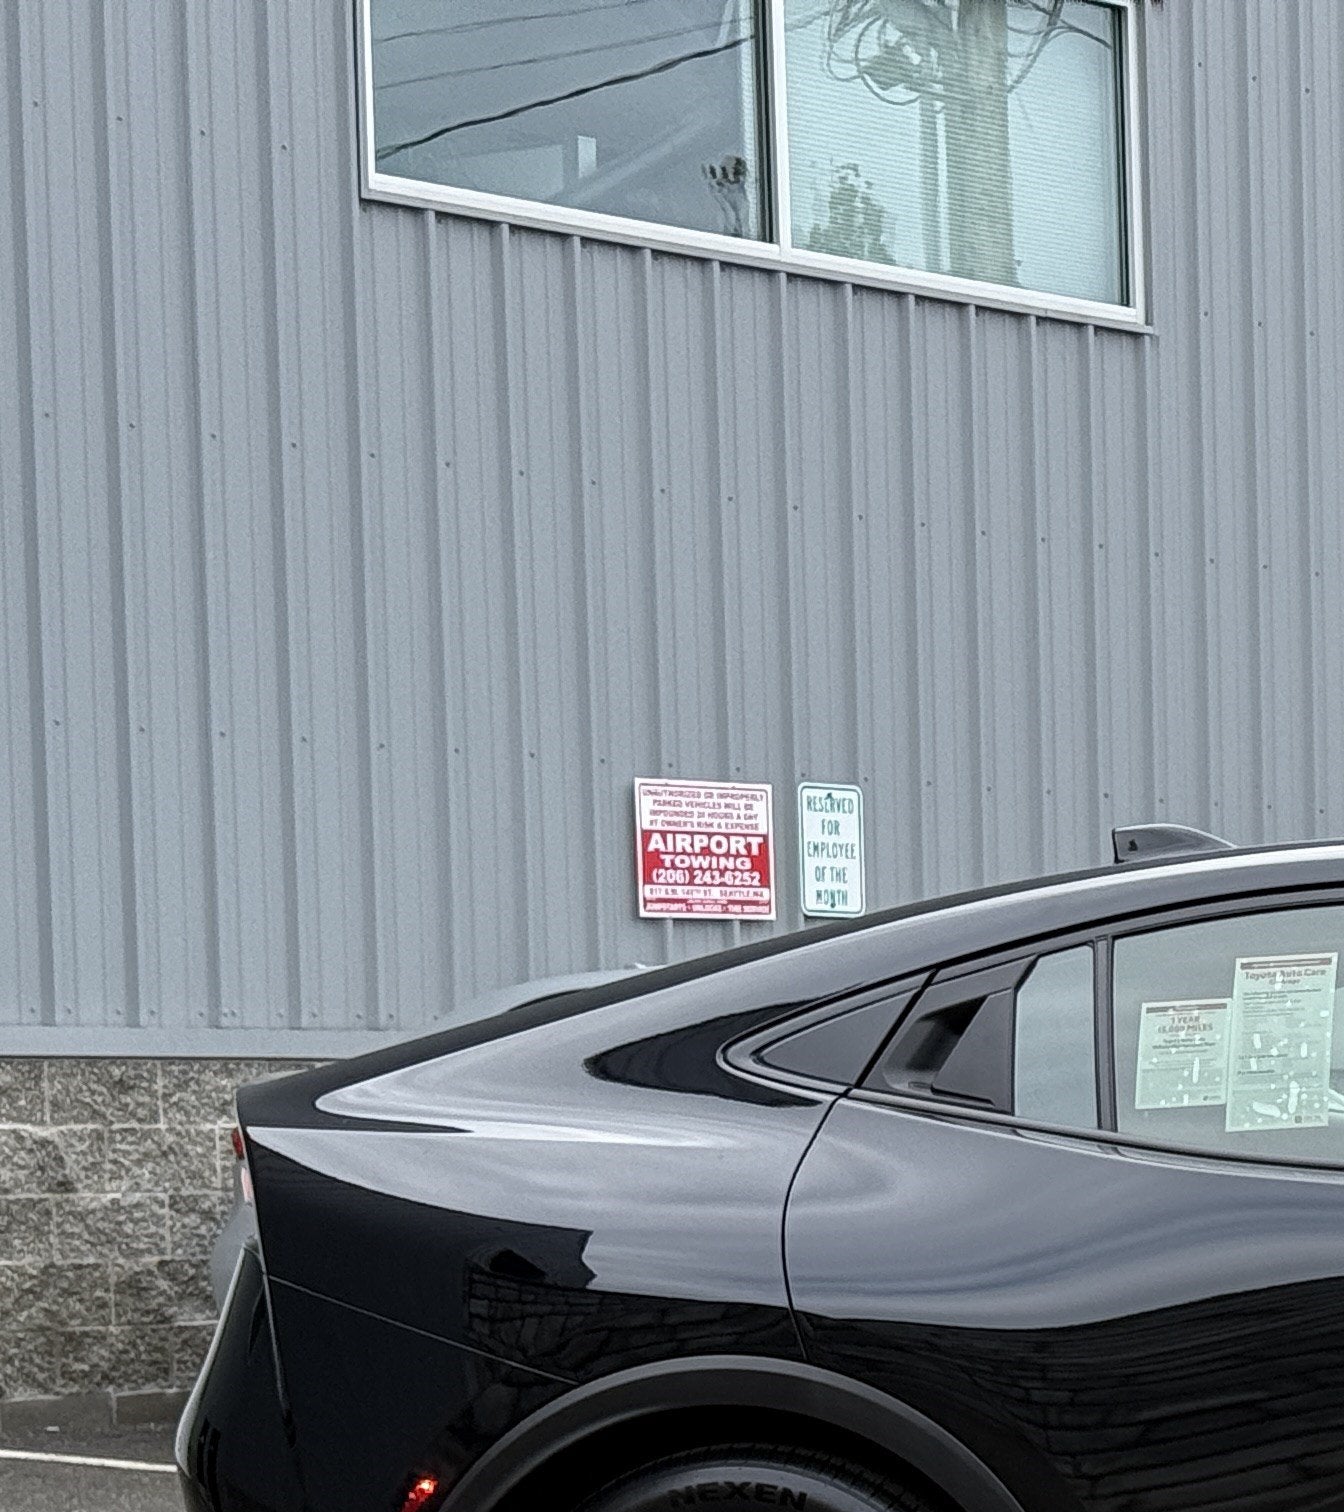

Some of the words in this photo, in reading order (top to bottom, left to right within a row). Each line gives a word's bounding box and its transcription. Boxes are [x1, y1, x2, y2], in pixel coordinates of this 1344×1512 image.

[685, 800, 722, 809] VEHICLES
[724, 802, 741, 811] WILL
[806, 795, 854, 814] RESERVED
[696, 820, 714, 829] RISK
[725, 822, 759, 830] EXPENSE
[821, 818, 840, 836] FOR
[647, 832, 764, 856] AIRPORT
[807, 841, 856, 860] EMPLOYEE
[660, 854, 752, 870] TOWING
[652, 868, 690, 884] (206)
[693, 870, 761, 886] 243-6252
[815, 866, 827, 882] OF
[829, 866, 848, 884] THE
[815, 889, 848, 906] MONTH
[1304, 968, 1327, 976] Care
[668, 1481, 808, 1511] NEXEN
